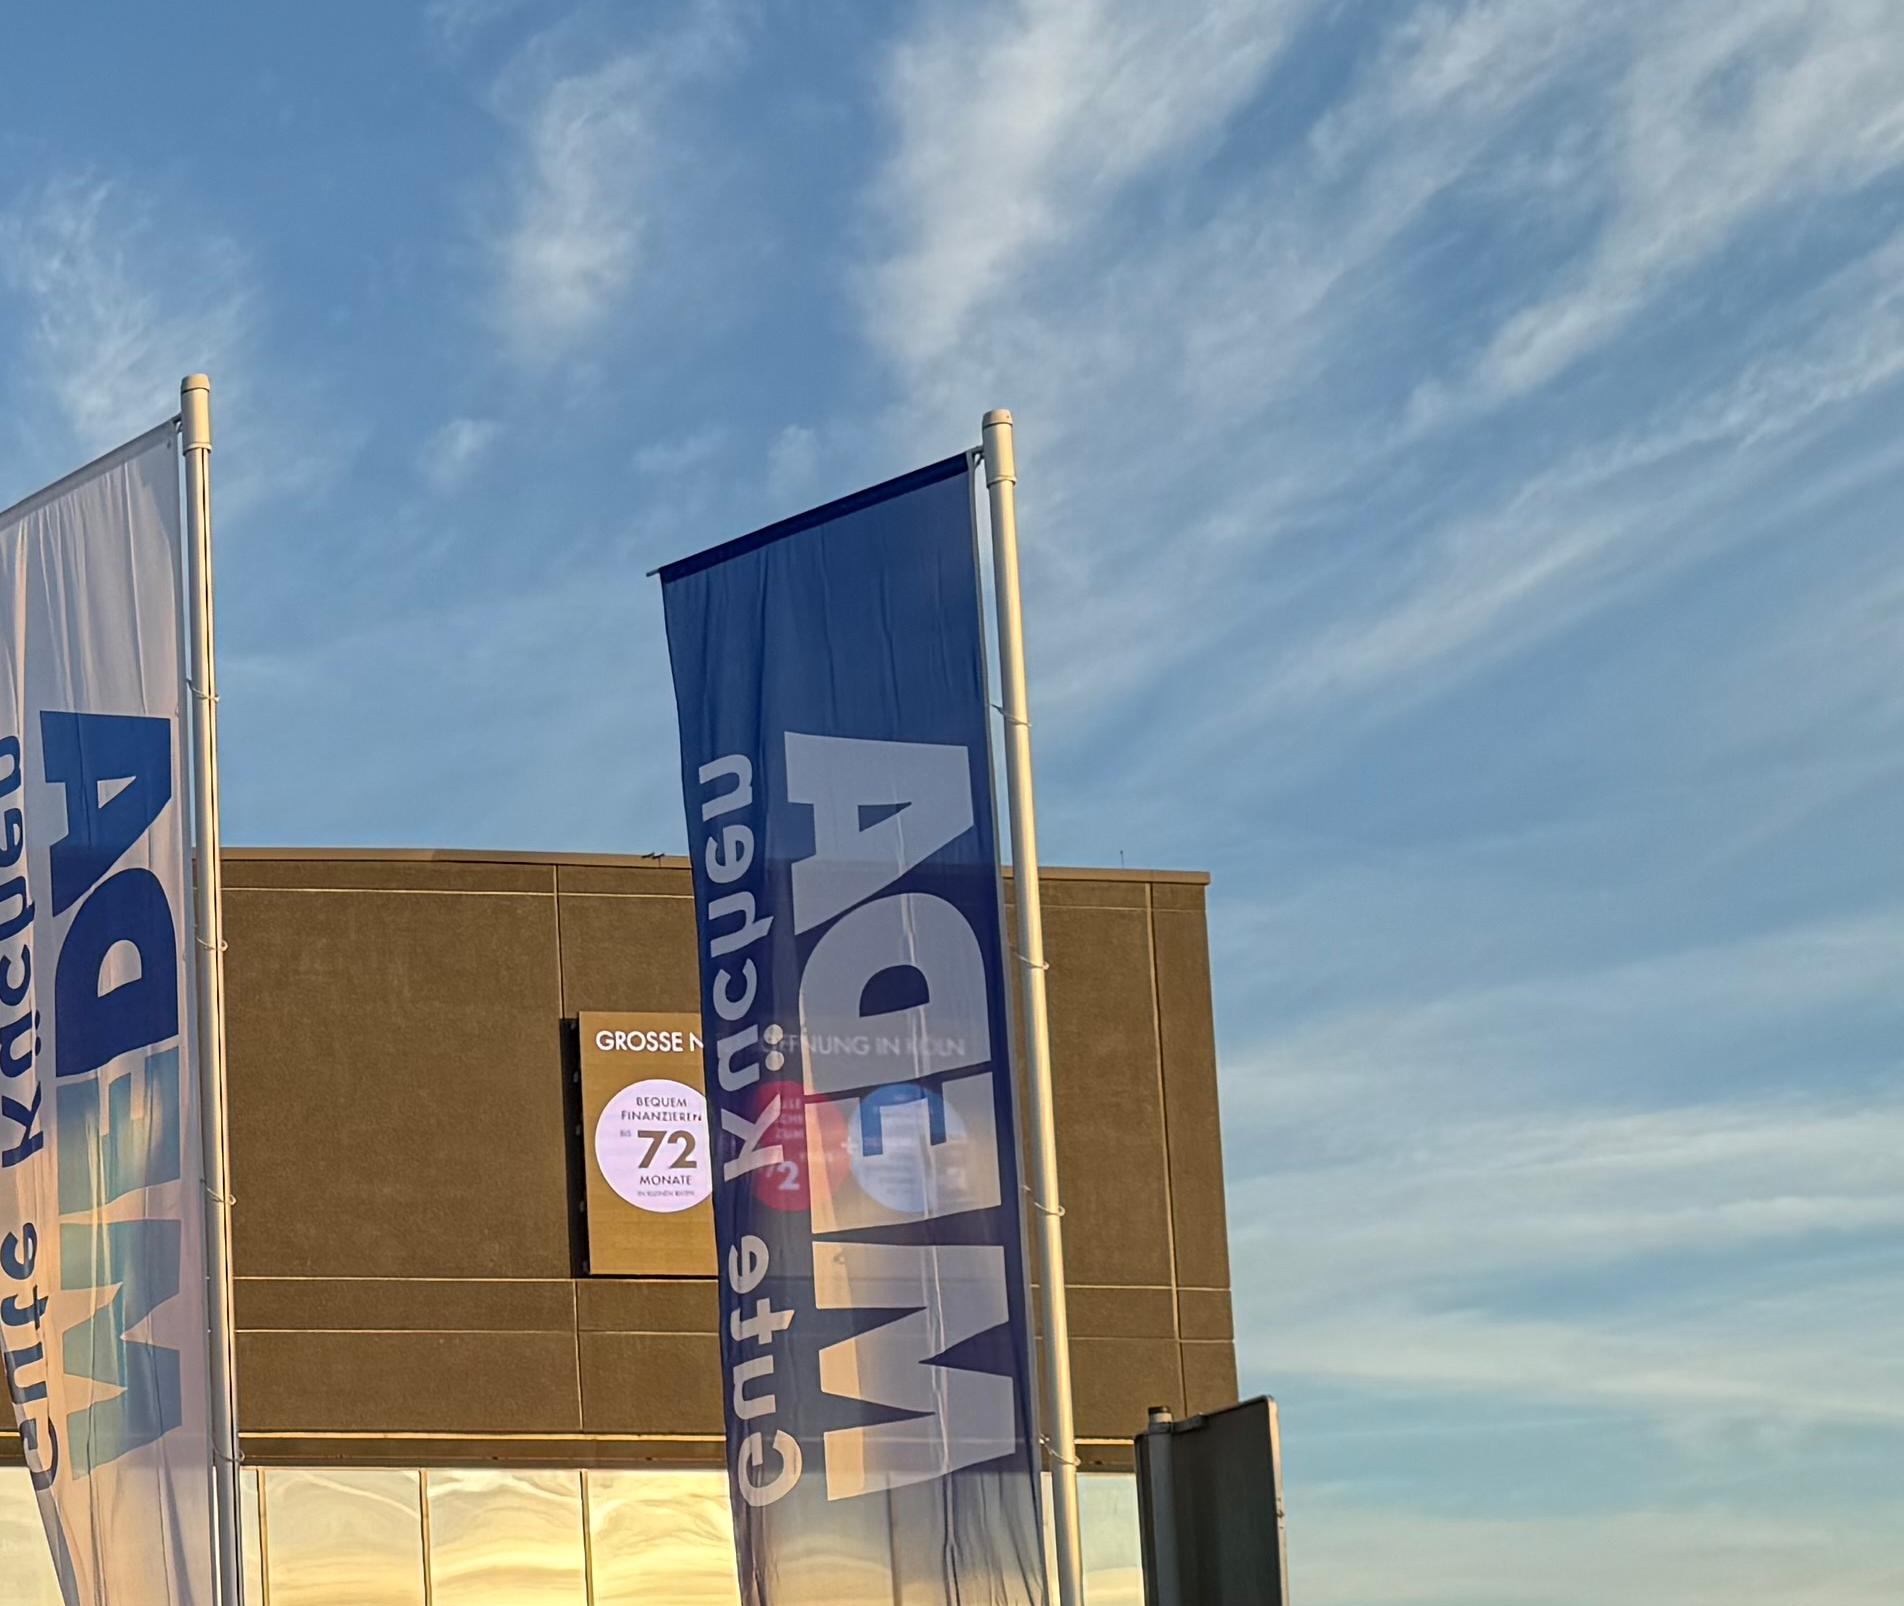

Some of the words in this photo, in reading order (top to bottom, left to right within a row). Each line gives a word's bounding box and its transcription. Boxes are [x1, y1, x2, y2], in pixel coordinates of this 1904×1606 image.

[595, 1030, 684, 1053] GROSSE
[635, 1096, 688, 1108] BEQUEM
[636, 1129, 697, 1169] 72
[639, 1174, 692, 1186] MONATE
